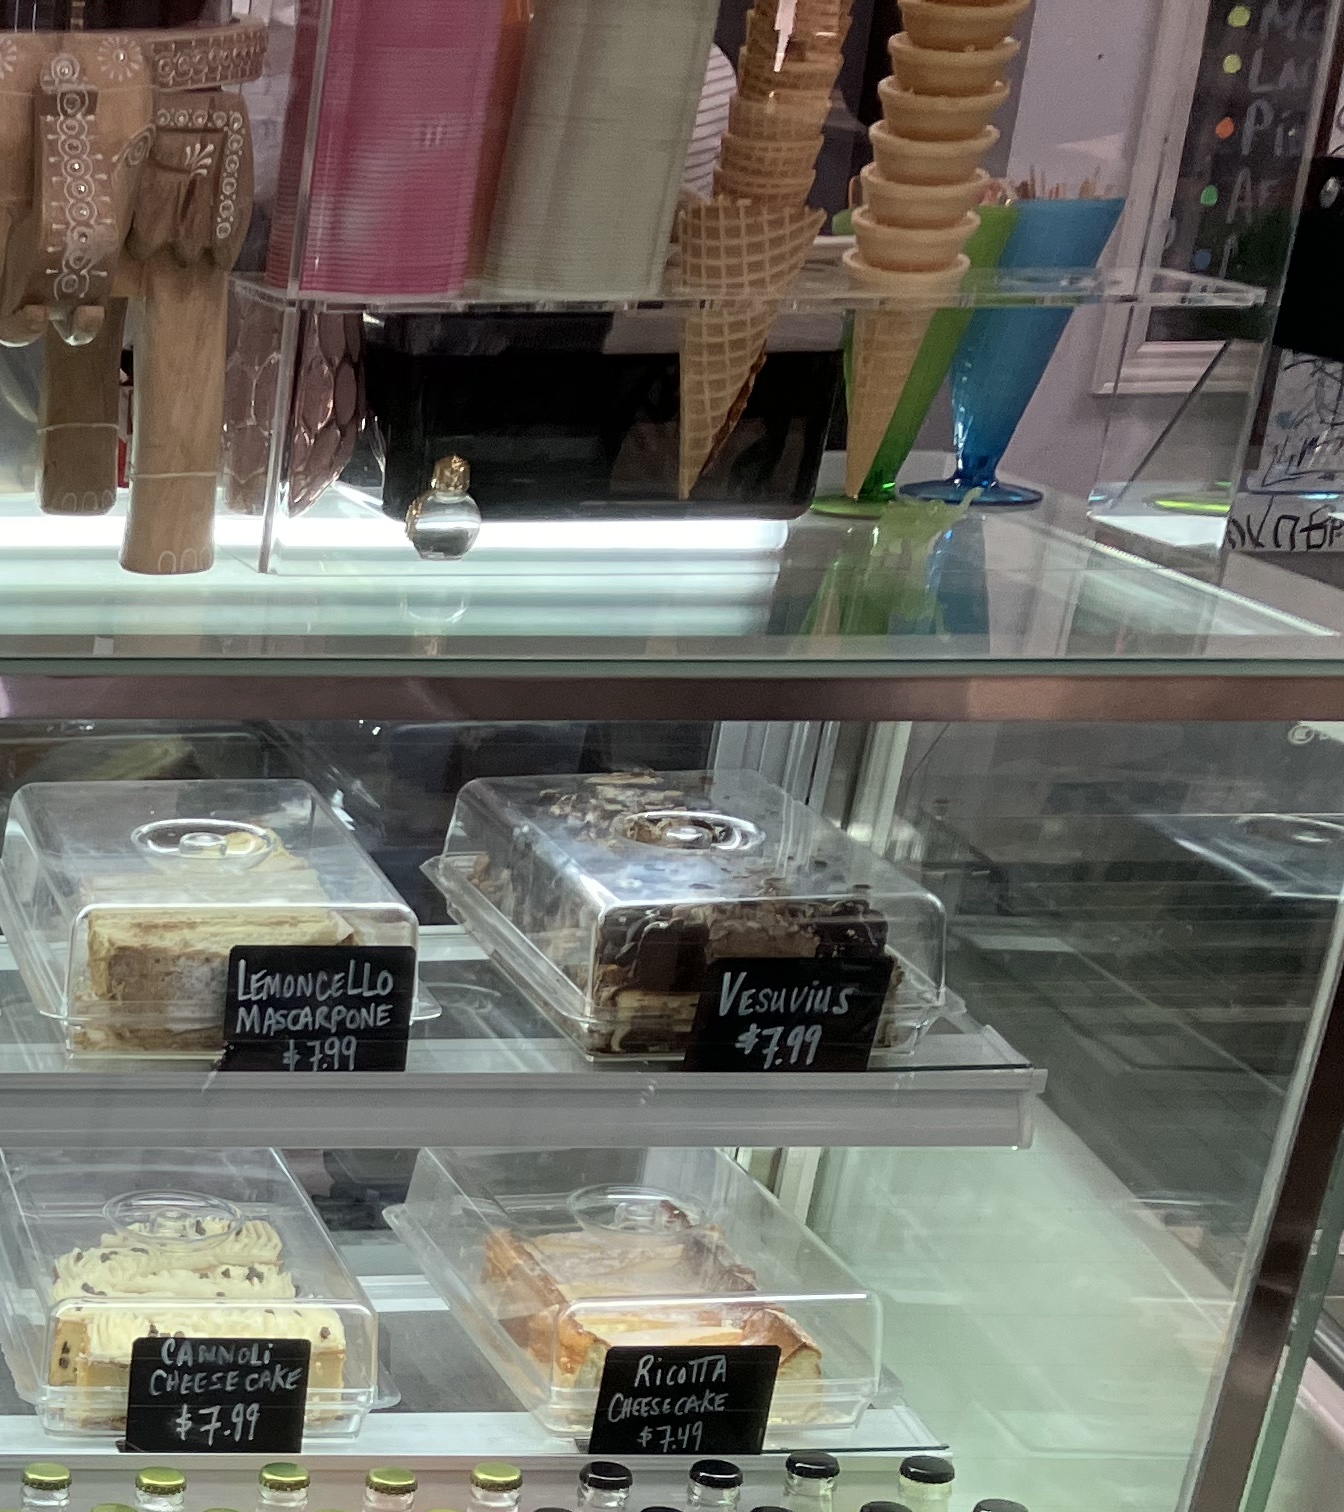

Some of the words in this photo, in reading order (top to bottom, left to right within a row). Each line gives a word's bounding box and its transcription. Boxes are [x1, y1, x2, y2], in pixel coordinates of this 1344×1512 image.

[235, 960, 395, 1001] LEMONCELLO
[235, 1003, 393, 1035] MASCARPONE
[282, 1035, 358, 1072] $7.99
[735, 1025, 822, 1071] $7.99
[247, 1364, 302, 1392] CAKE
[175, 1403, 261, 1445] $7.99
[636, 1421, 703, 1453] $7.49
